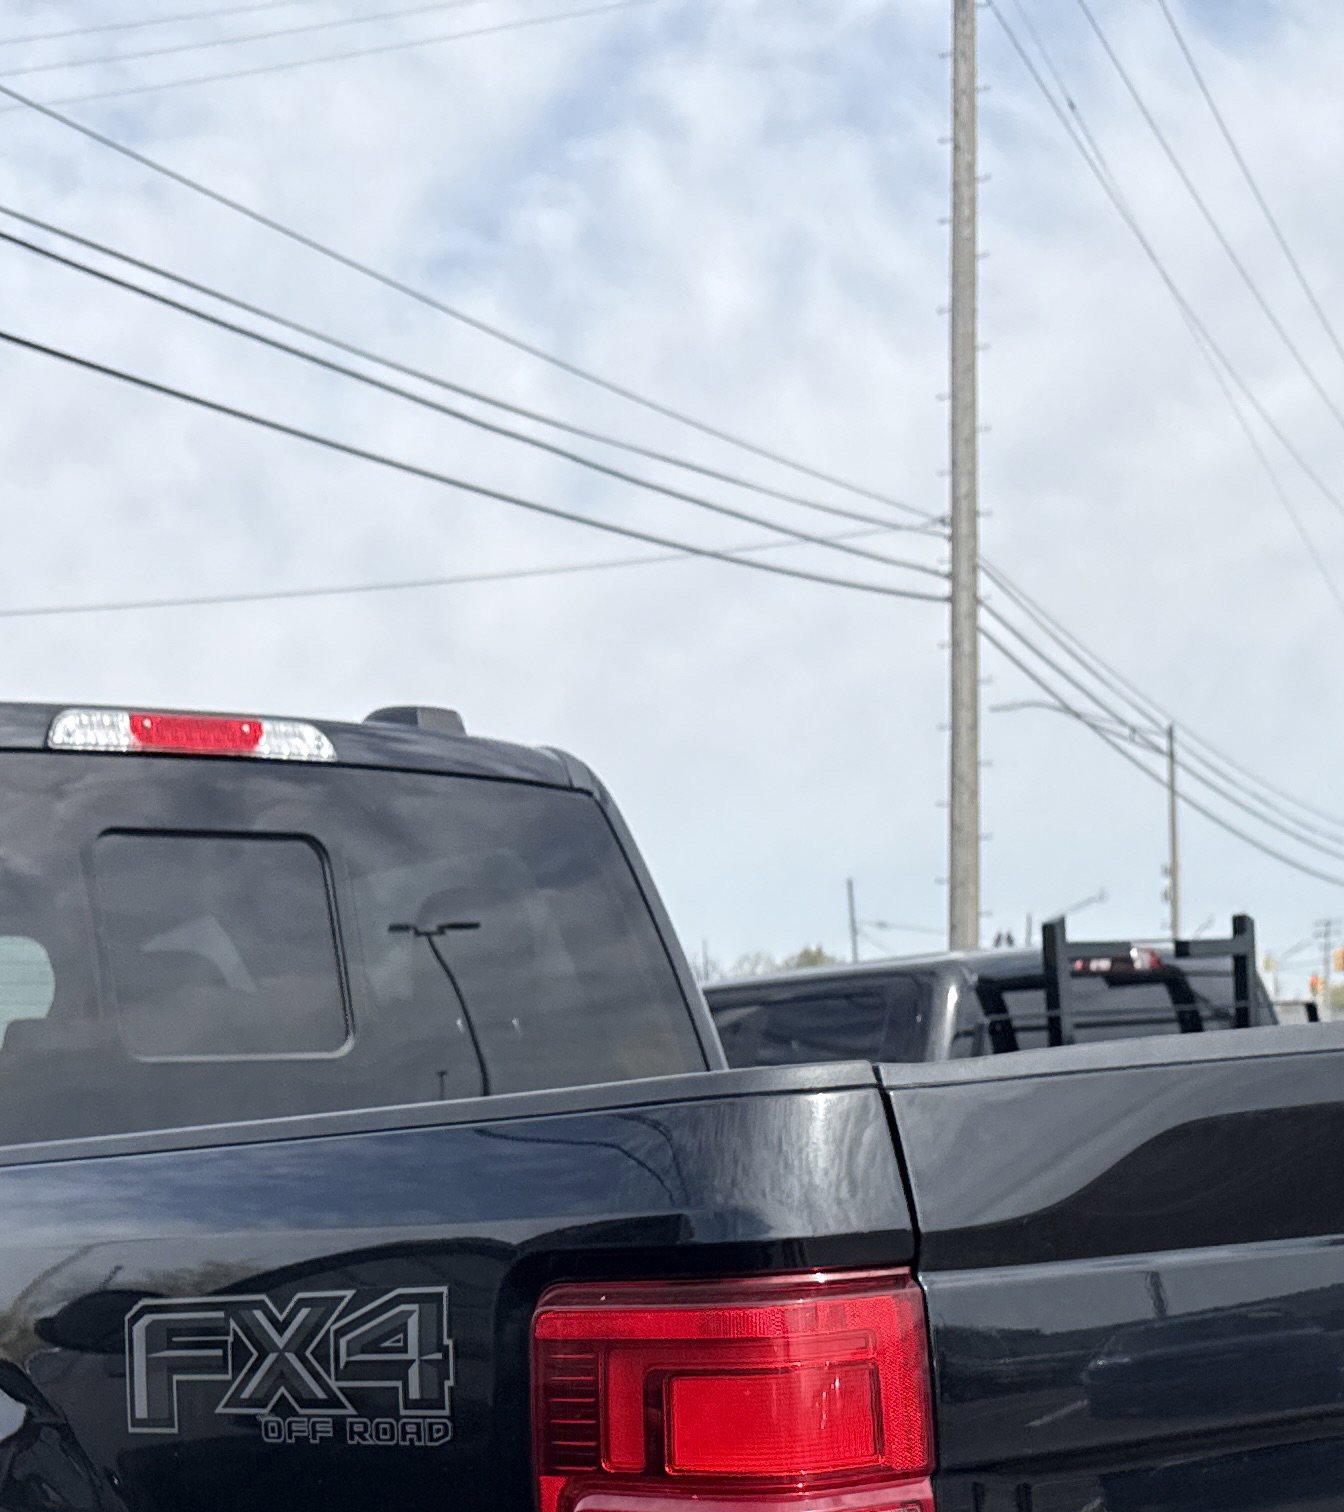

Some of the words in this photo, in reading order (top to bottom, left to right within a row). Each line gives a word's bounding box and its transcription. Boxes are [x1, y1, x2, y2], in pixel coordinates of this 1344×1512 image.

[124, 1286, 453, 1433] FX4
[261, 1416, 333, 1444] OFF
[345, 1416, 453, 1446] ROAD
